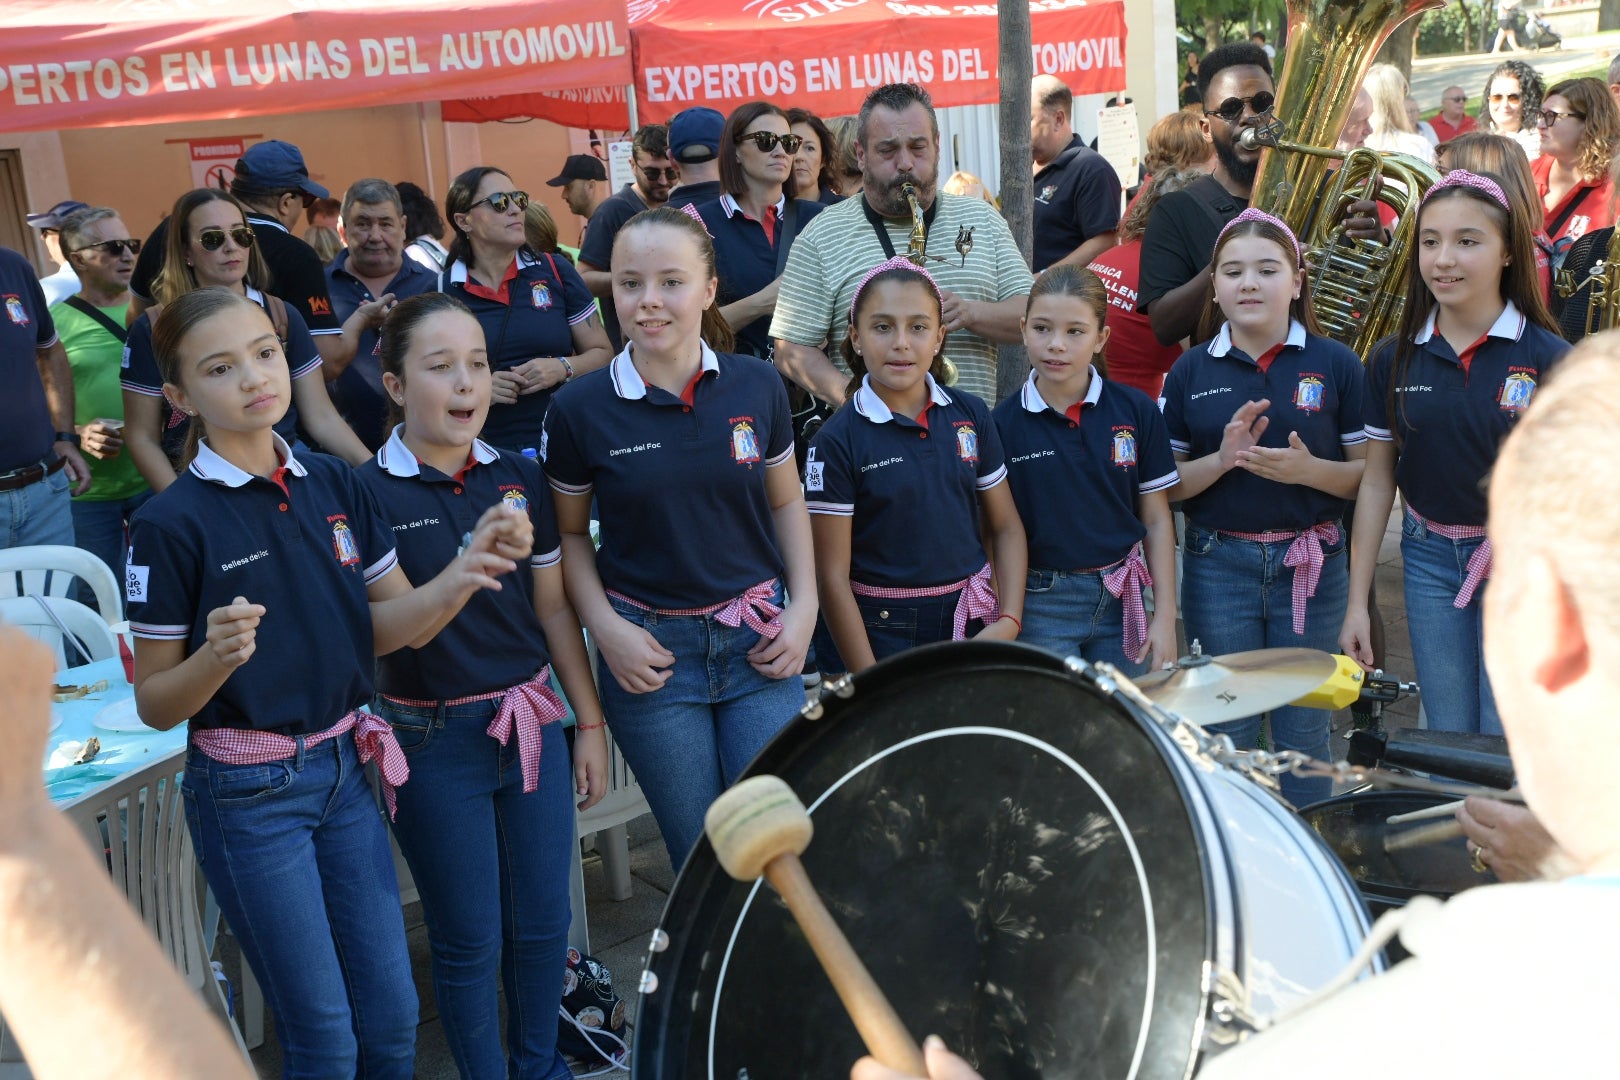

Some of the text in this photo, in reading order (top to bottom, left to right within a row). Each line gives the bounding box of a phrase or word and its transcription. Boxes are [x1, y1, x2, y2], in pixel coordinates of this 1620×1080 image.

[160, 50, 217, 92] EN
[225, 39, 352, 86] LUNAS
[362, 34, 431, 77] DEL
[439, 20, 626, 71] AUTOMOVIL
[645, 37, 1122, 102] EXPERTOS EN LUNAS DEL TOMOVIL
[1101, 278, 1138, 301] ALLEN
[1107, 293, 1133, 312] LEN
[1191, 391, 1208, 400] Dama
[609, 442, 662, 456] Dama del Foc
[879, 458, 890, 467] del
[890, 456, 904, 464] Foc
[1011, 455, 1030, 463] Dama
[391, 518, 440, 532] ma del Foc
[221, 559, 250, 571] Bellesa
